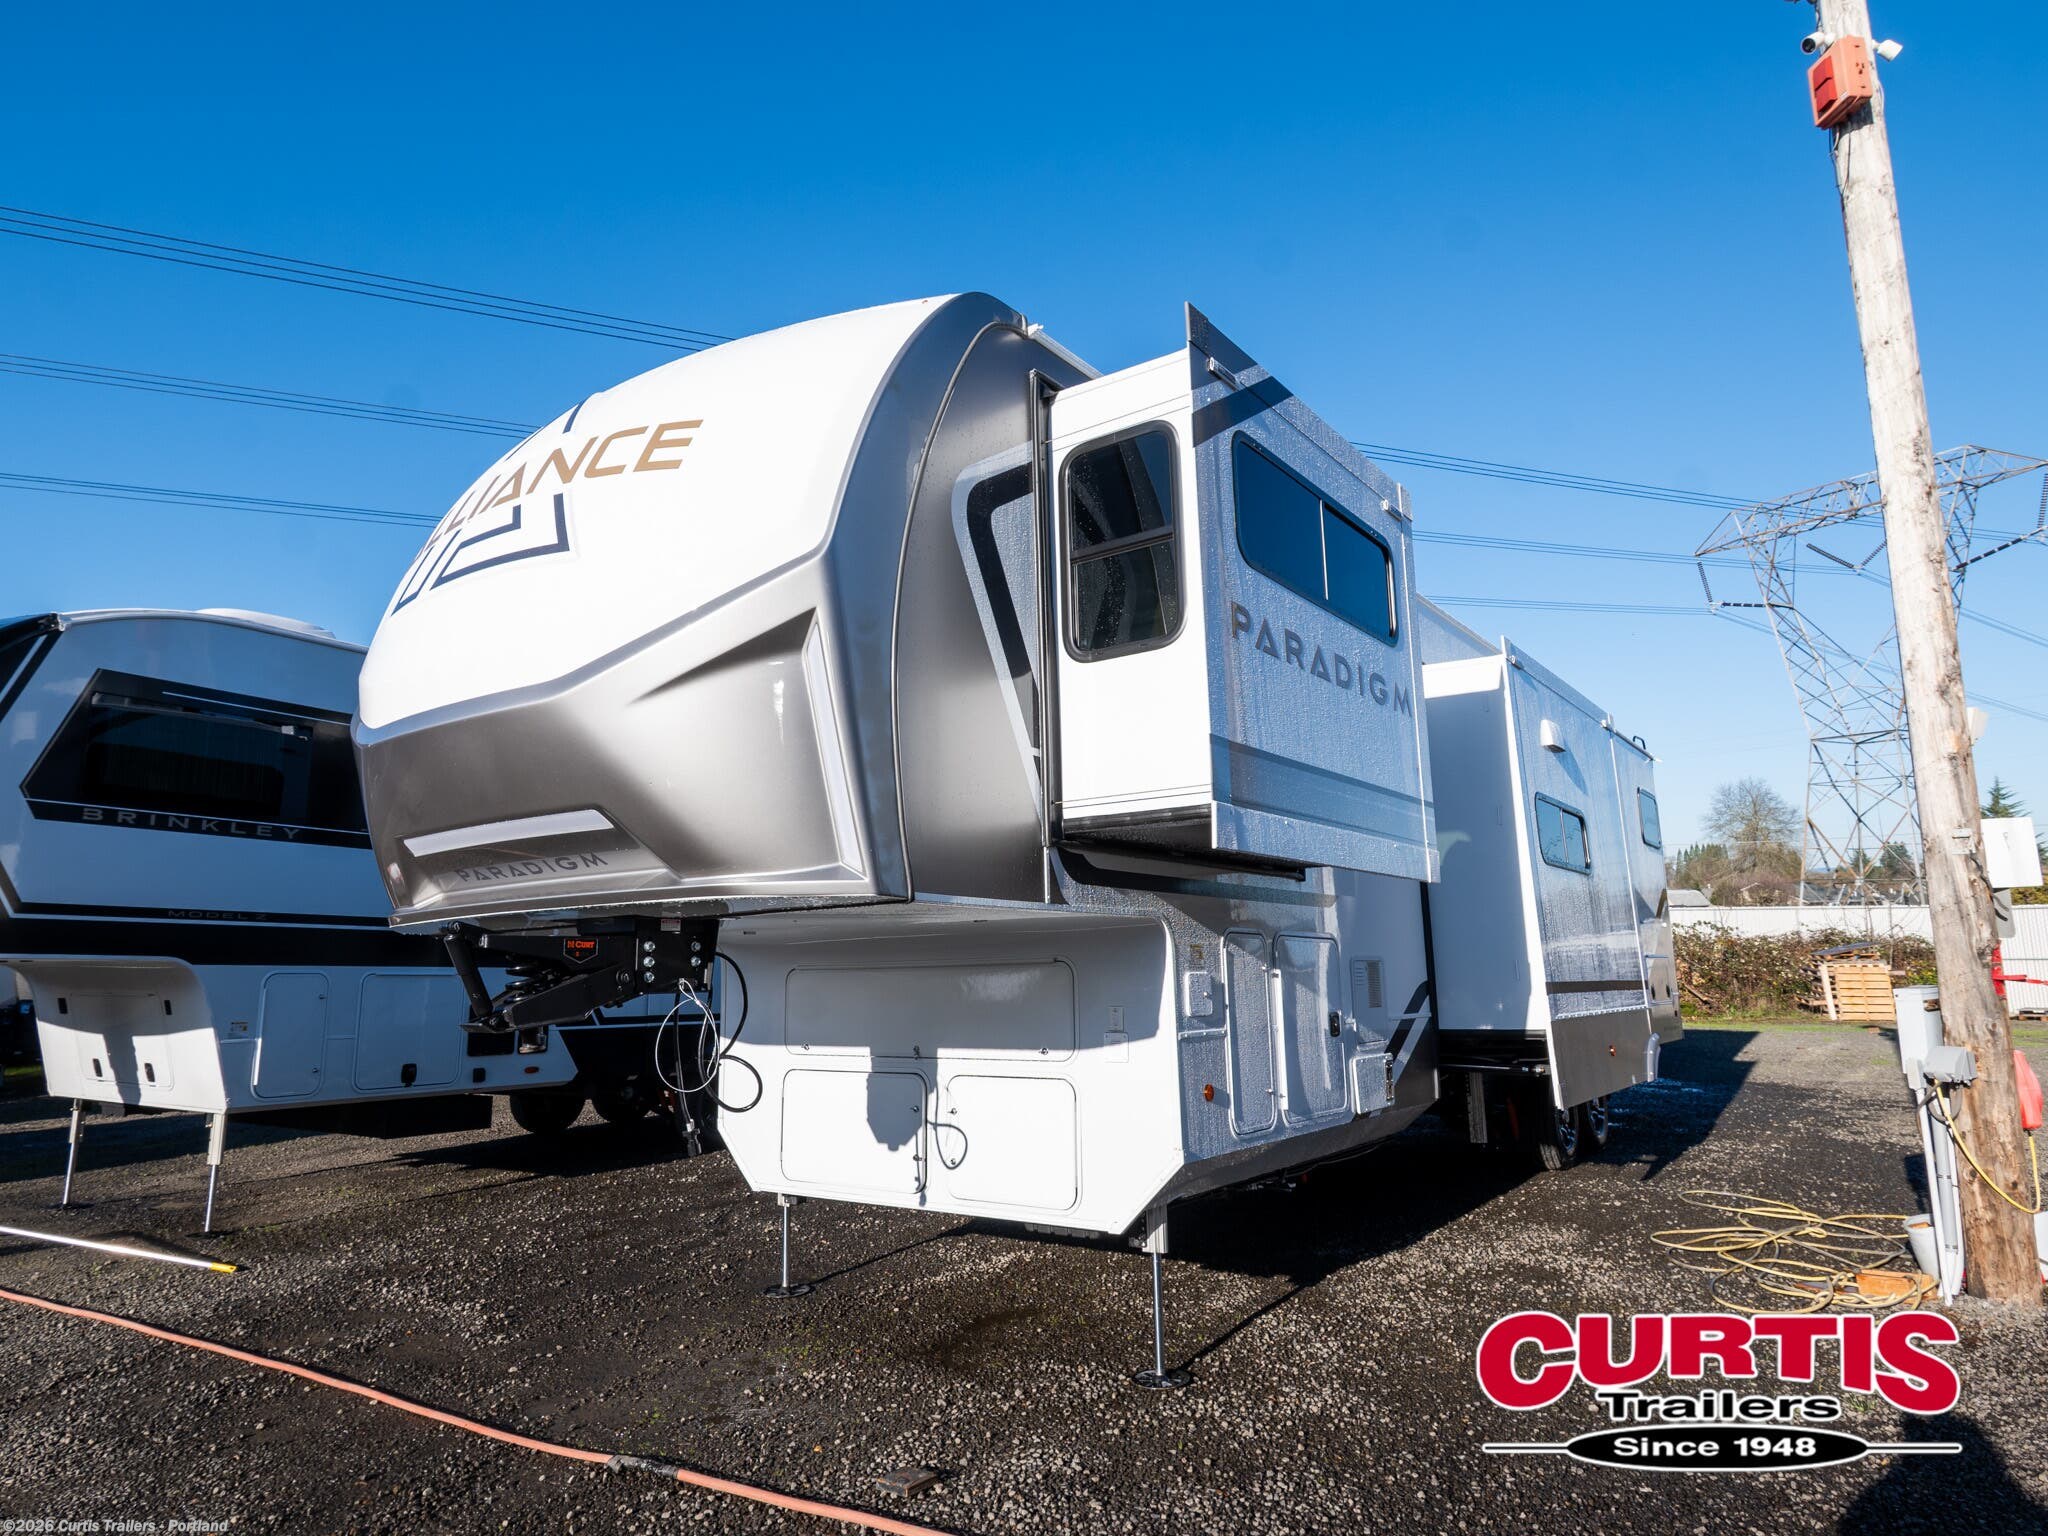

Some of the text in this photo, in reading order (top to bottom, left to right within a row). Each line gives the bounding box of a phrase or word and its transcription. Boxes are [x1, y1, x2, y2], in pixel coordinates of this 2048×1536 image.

[414, 419, 704, 559] LLIANCE
[1231, 601, 1412, 717] PARADIGM
[82, 807, 299, 840] BRINKLEY
[454, 852, 609, 882] PARADIGM
[167, 909, 249, 921] MODEL
